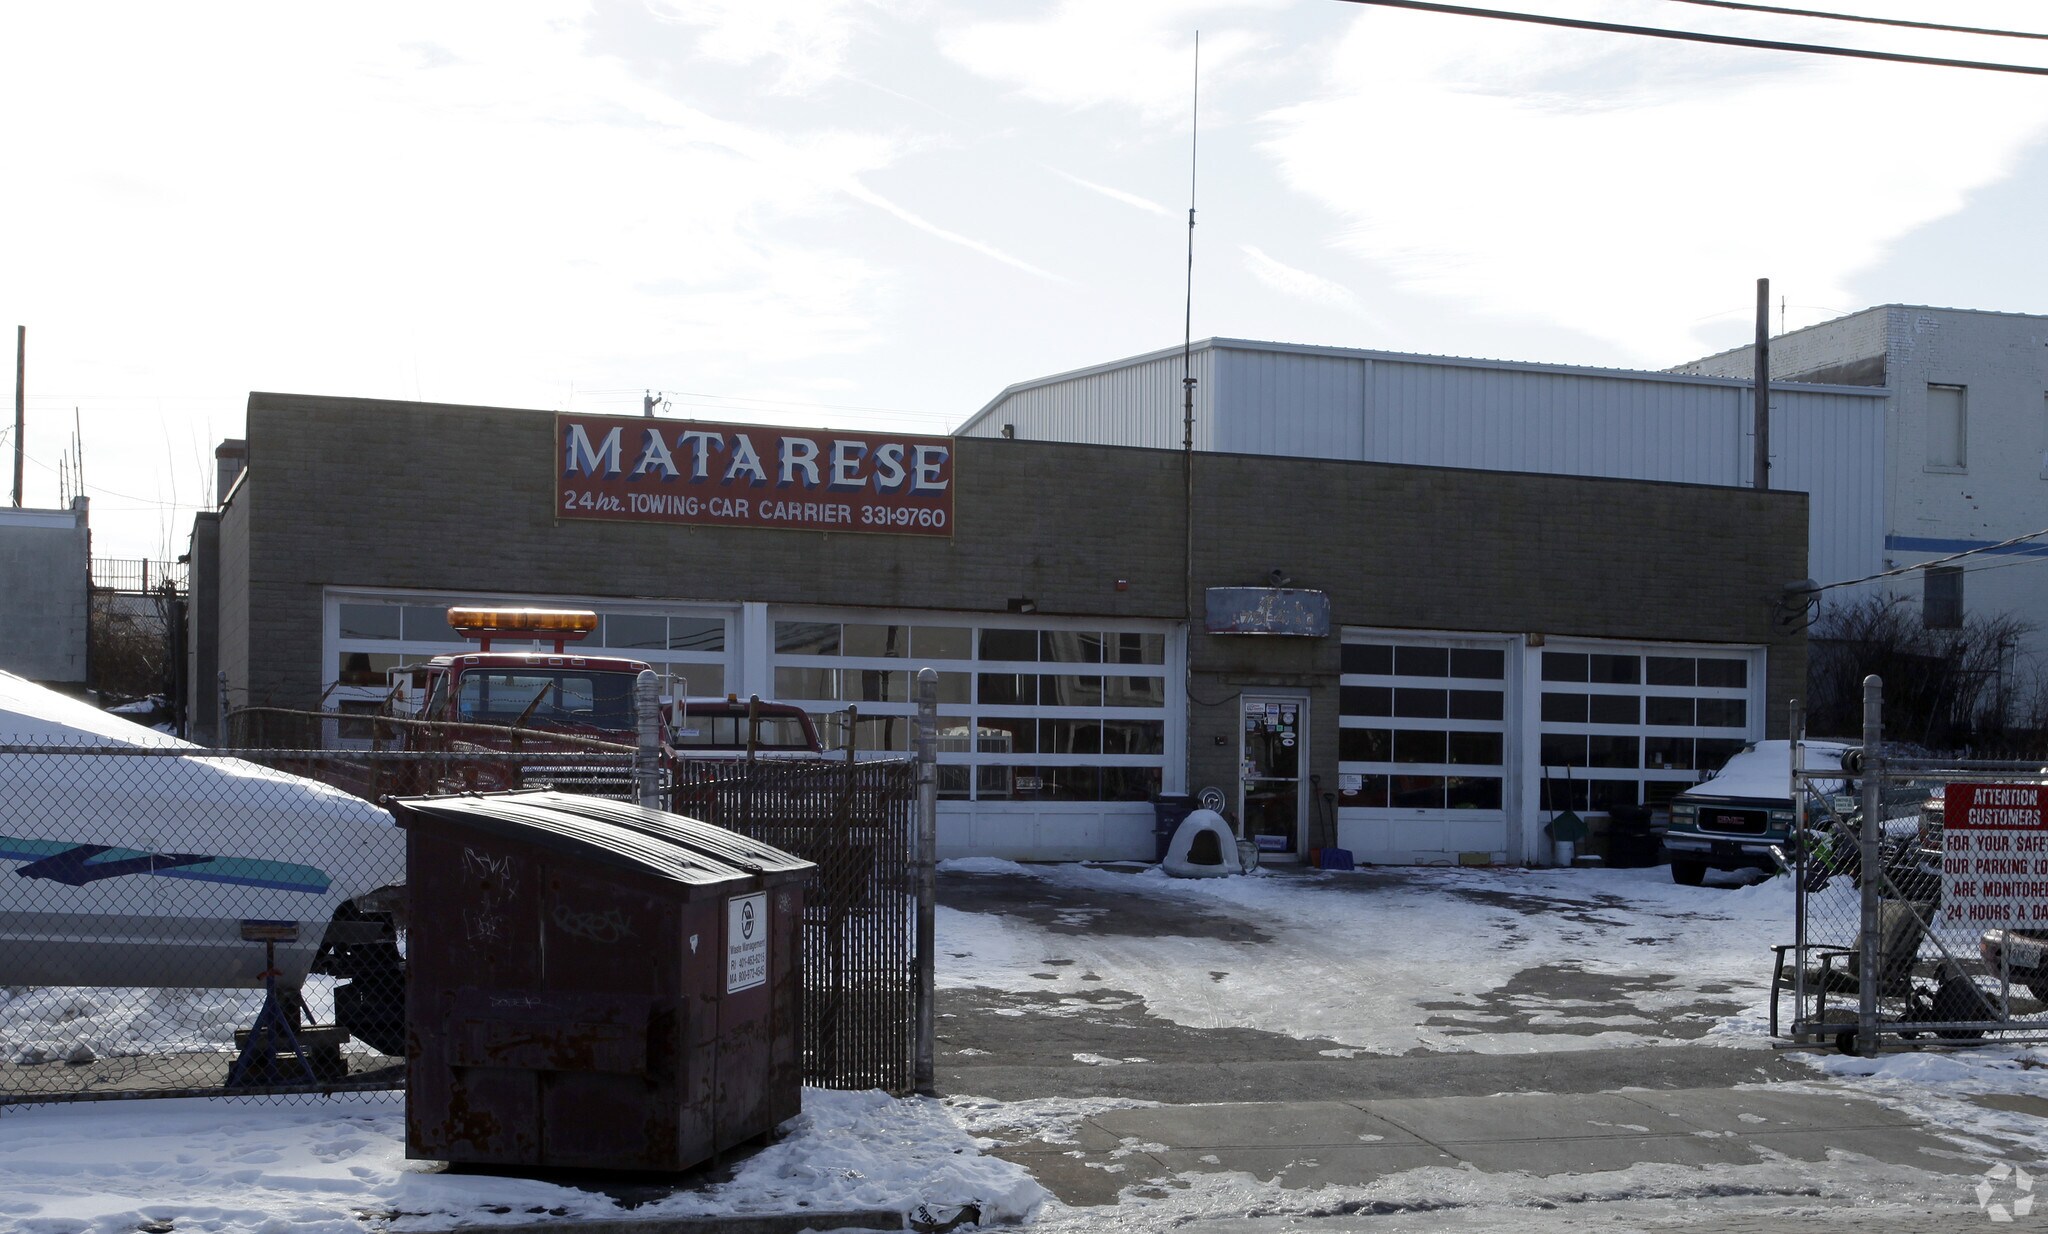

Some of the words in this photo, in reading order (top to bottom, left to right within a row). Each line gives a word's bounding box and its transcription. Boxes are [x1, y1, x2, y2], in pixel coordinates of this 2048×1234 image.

[564, 423, 950, 494] MATARESE
[564, 489, 626, 512] 24hr.
[759, 500, 852, 523] CARRIER
[1973, 788, 2038, 806] ATTENTION
[1717, 815, 1745, 825] GMC
[1968, 808, 2041, 826] CUSTOMERS
[1947, 835, 1969, 851] FOR
[1977, 835, 2009, 852] YOUR
[2017, 836, 2048, 852] SAFE
[1944, 858, 1969, 874] OUR
[1975, 858, 2028, 875] PARKING
[1953, 881, 1977, 897] ARE
[1947, 904, 1963, 920] 24
[1970, 904, 2011, 921] HOURS
[2017, 904, 2026, 921] A
[729, 973, 738, 984] MA
